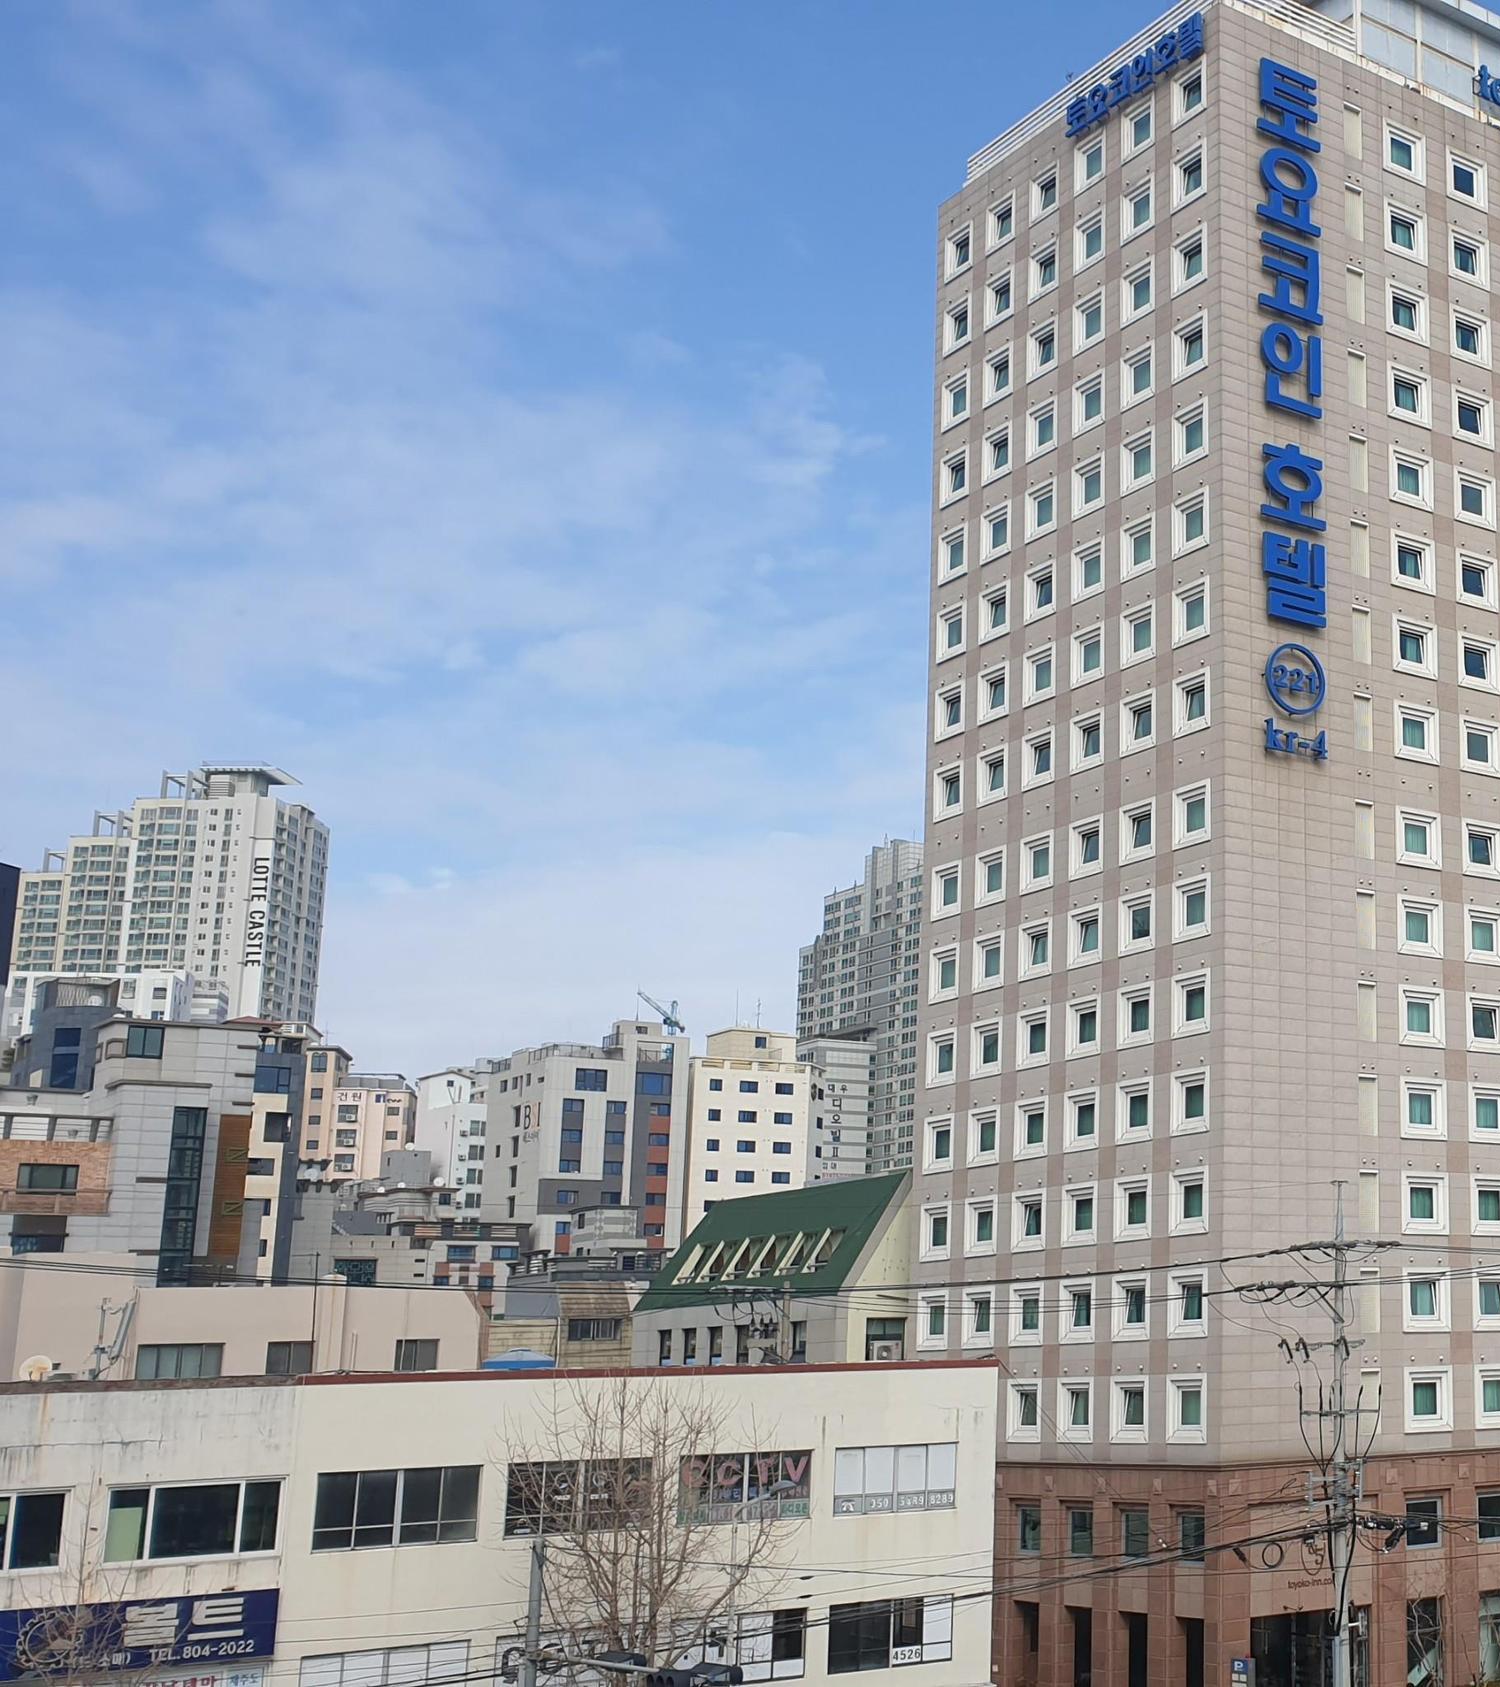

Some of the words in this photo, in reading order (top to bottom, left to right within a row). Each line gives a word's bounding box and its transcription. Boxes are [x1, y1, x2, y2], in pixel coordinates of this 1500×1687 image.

[1065, 12, 1205, 138] 토요코인호텔
[1256, 57, 1324, 420] 토요코인
[1260, 442, 1327, 630] 호텔
[1272, 664, 1318, 696] 221
[1263, 717, 1328, 760] kr-4
[251, 857, 270, 902] LOTTE
[244, 910, 266, 967] CASTLE
[1287, 1577, 1335, 1591] toyoko-inn.co
[121, 1597, 245, 1648] 볼트
[892, 1648, 921, 1661] 4526
[1233, 1660, 1244, 1672] P
